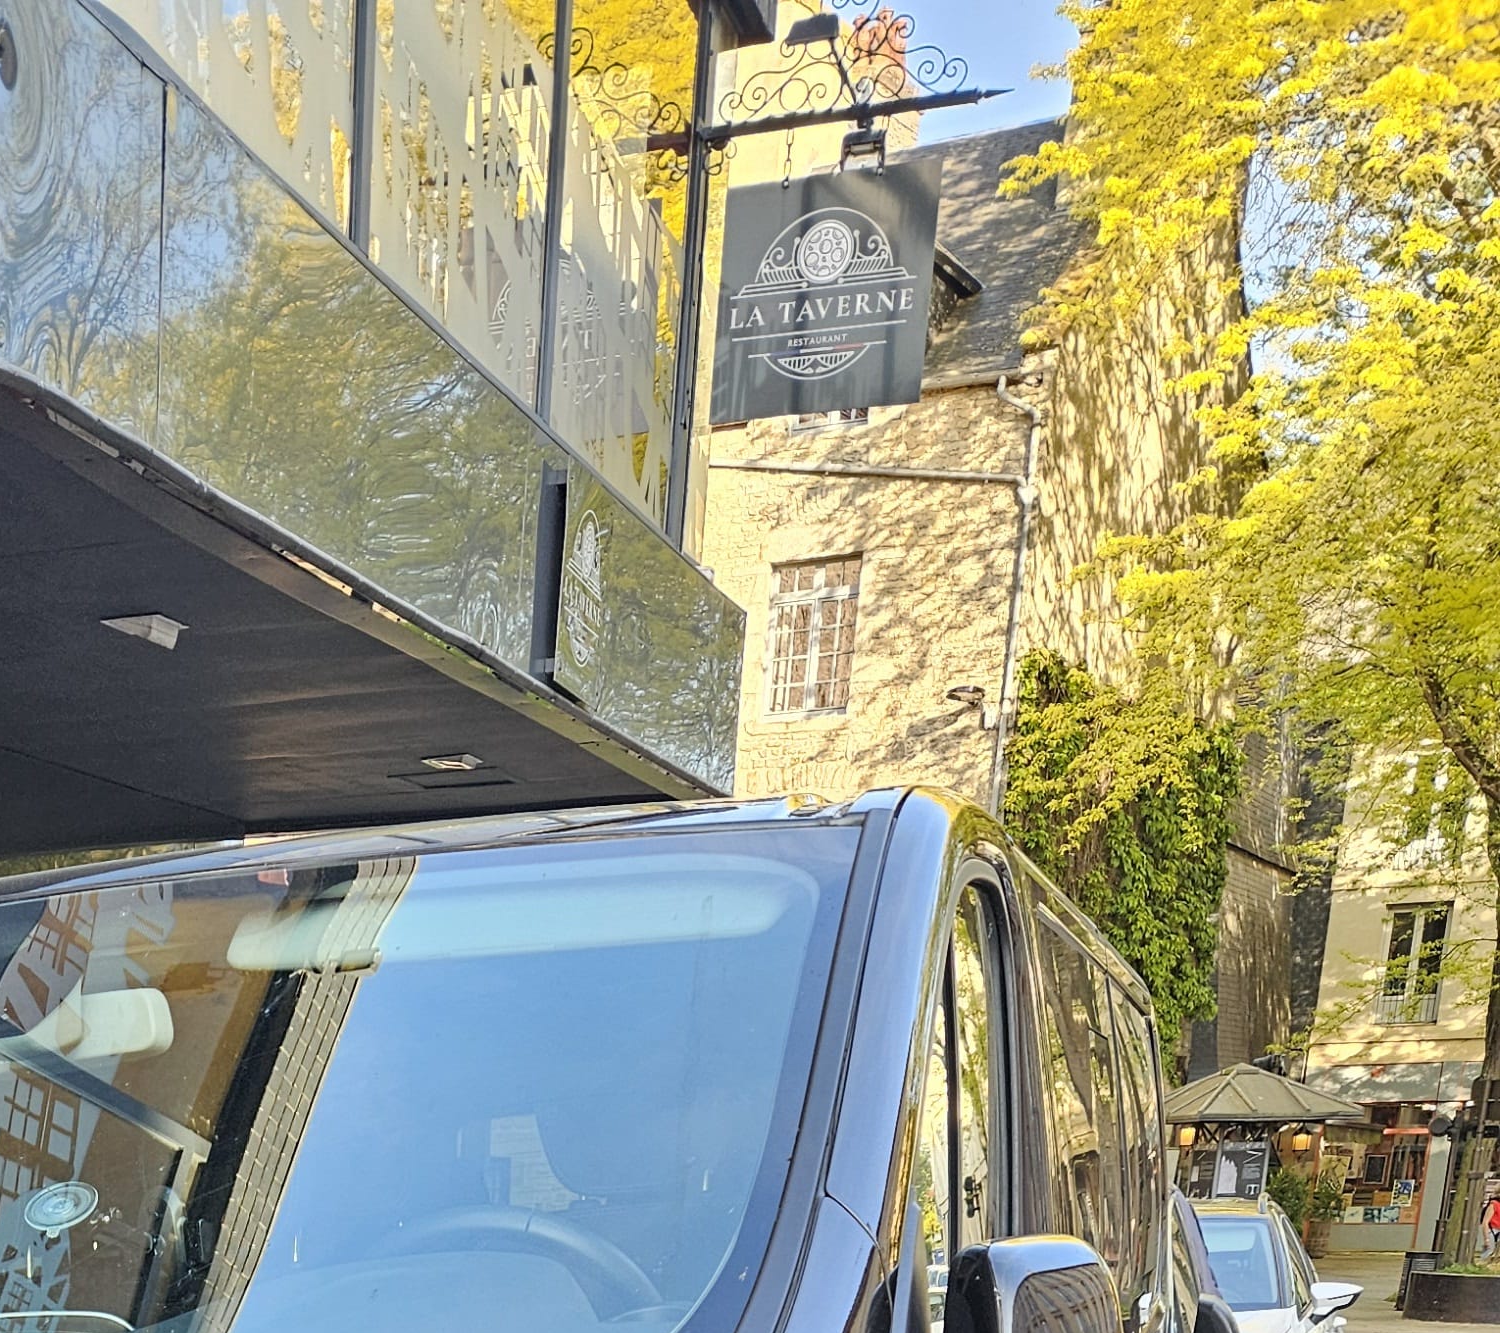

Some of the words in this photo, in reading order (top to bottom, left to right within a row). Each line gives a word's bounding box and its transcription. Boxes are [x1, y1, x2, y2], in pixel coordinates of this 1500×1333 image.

[729, 306, 765, 330] LA
[778, 288, 915, 323] TAVERNE
[787, 333, 849, 348] RESTAURANT
